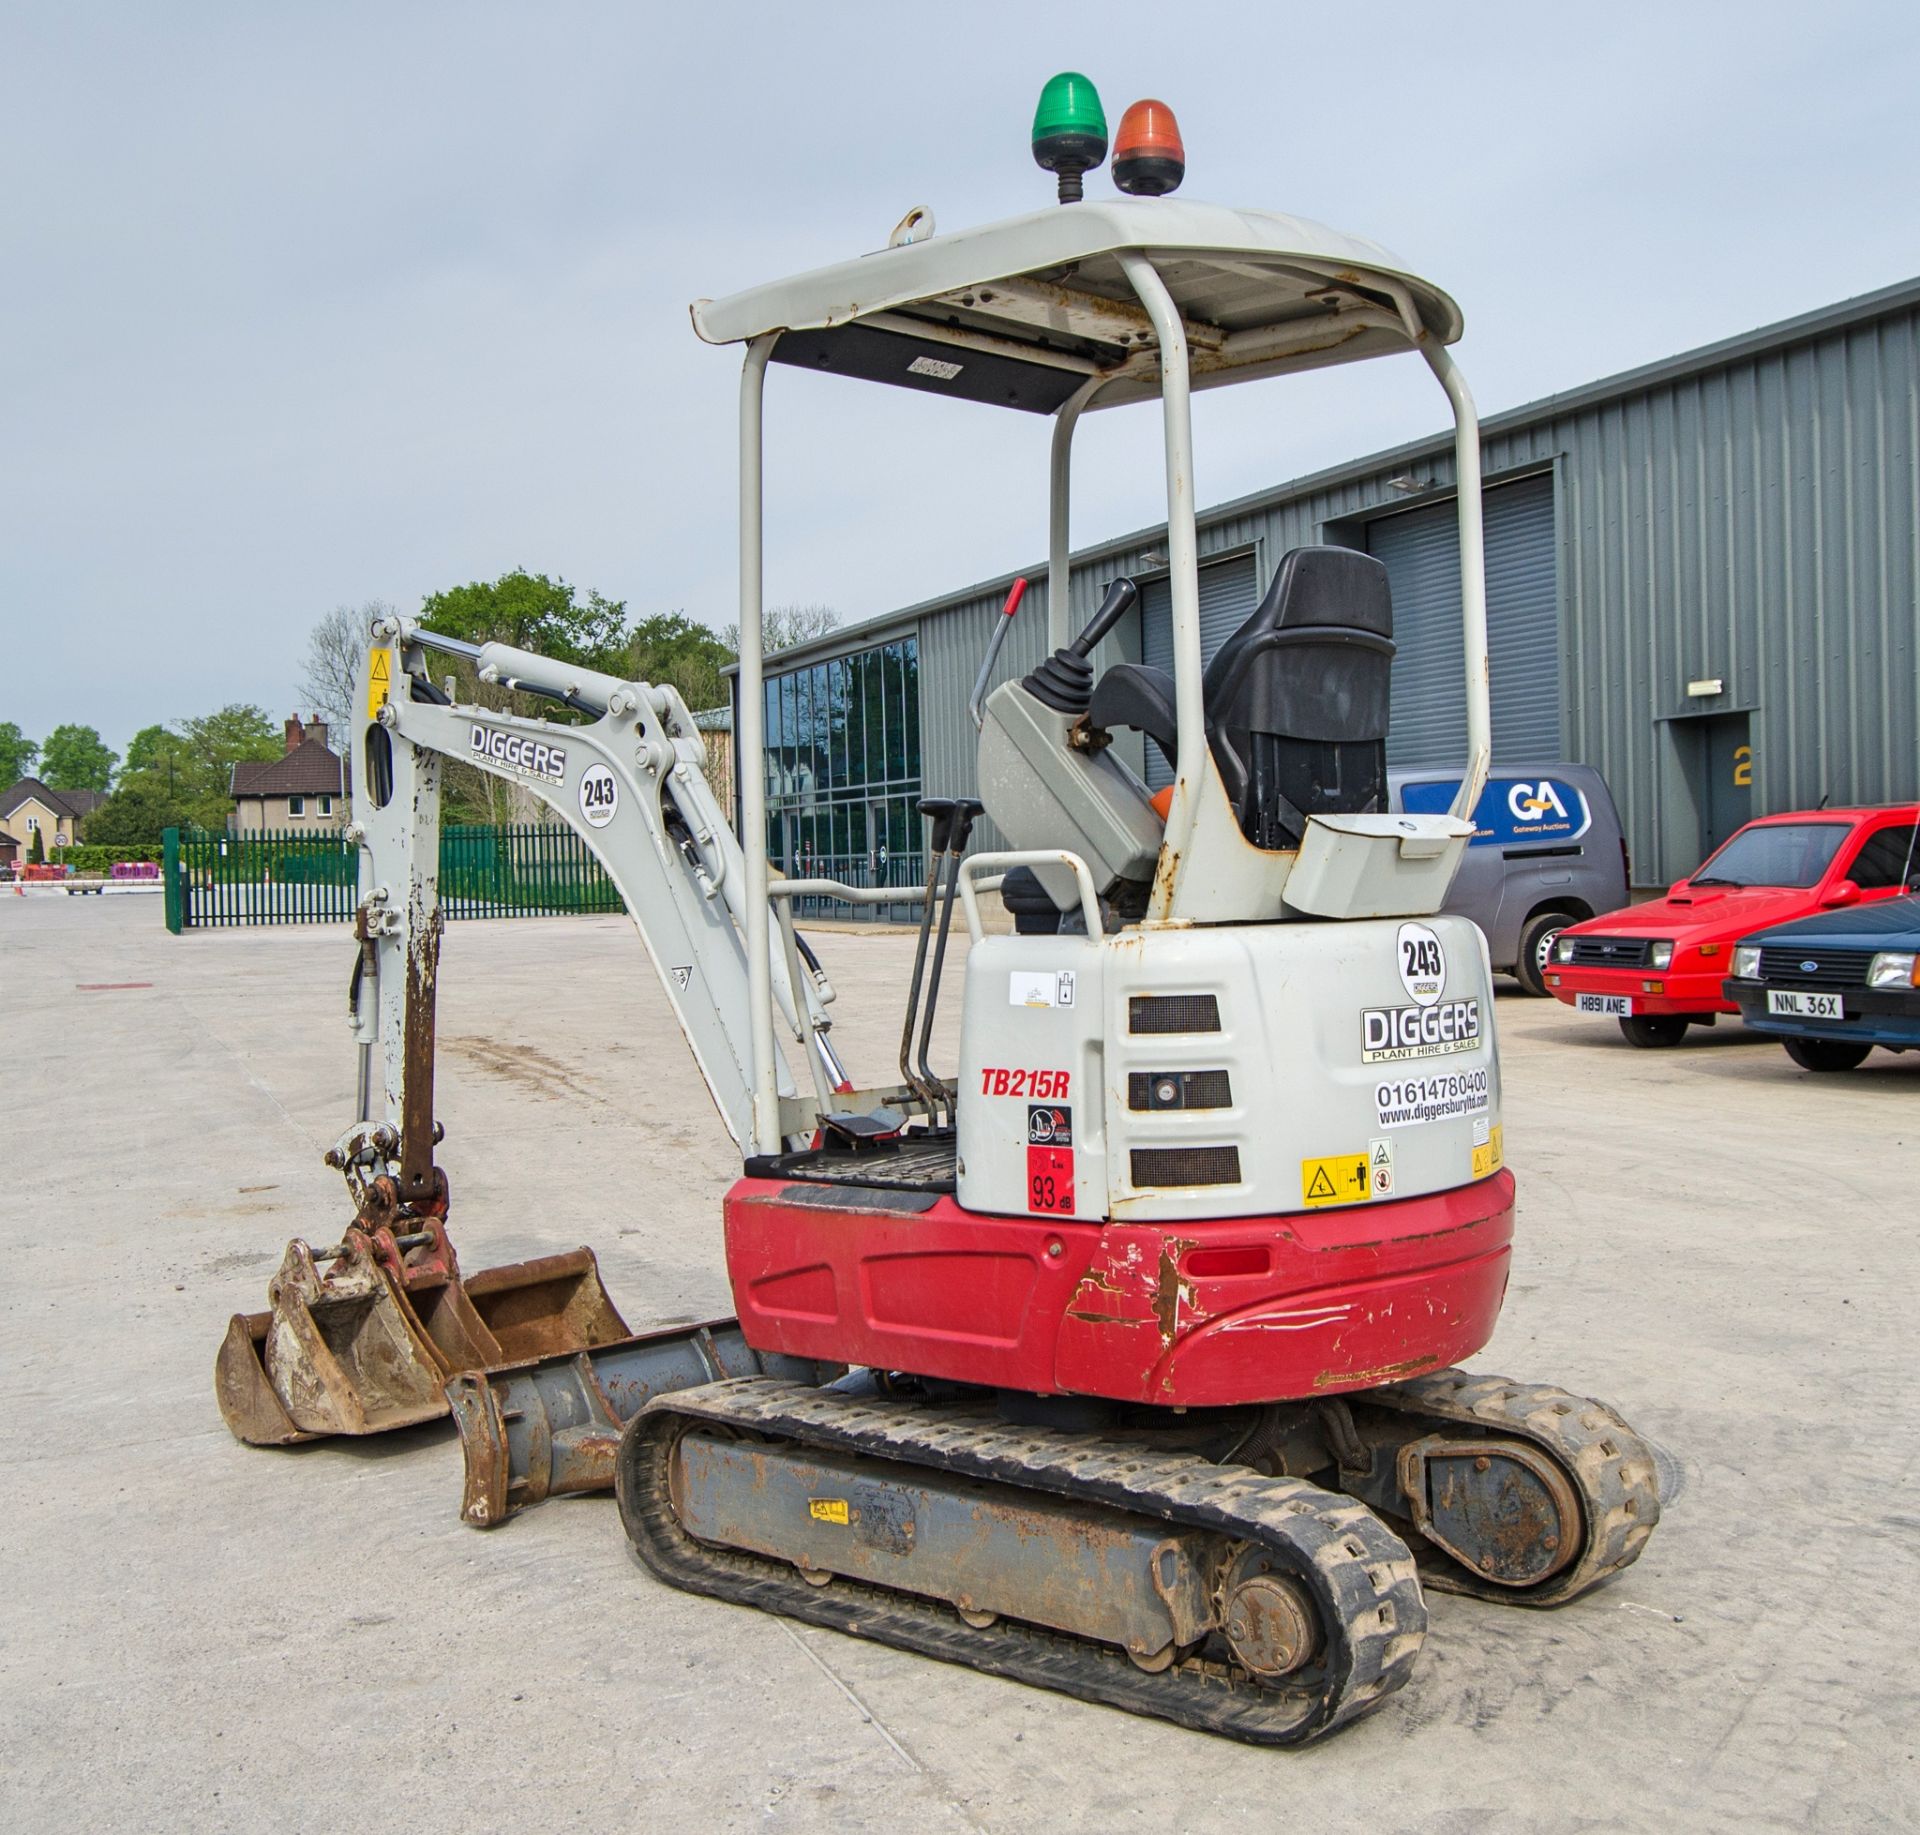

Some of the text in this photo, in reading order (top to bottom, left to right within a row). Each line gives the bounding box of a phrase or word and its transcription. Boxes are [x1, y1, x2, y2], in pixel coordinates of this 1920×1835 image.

[471, 724, 566, 777] DIGGERS
[473, 751, 498, 765] PLANT
[500, 760, 519, 772] HIRE
[530, 769, 557, 784] SALES
[584, 777, 614, 807] 243
[1508, 781, 1569, 820] GA
[1513, 823, 1570, 833] Gateway Auctions
[1403, 940, 1442, 977] 243
[1581, 996, 1626, 1014] H891 ANE
[1775, 994, 1837, 1015] NNL 36X
[1364, 1001, 1479, 1050] DIGGERS
[1372, 1039, 1476, 1061] PLANT HIRE & SALES
[981, 1068, 1070, 1099] TB215R
[1378, 1071, 1487, 1107] 01614780400
[1380, 1094, 1488, 1125] www.diggersburyltd.com
[1033, 1175, 1072, 1209] 93 dB
